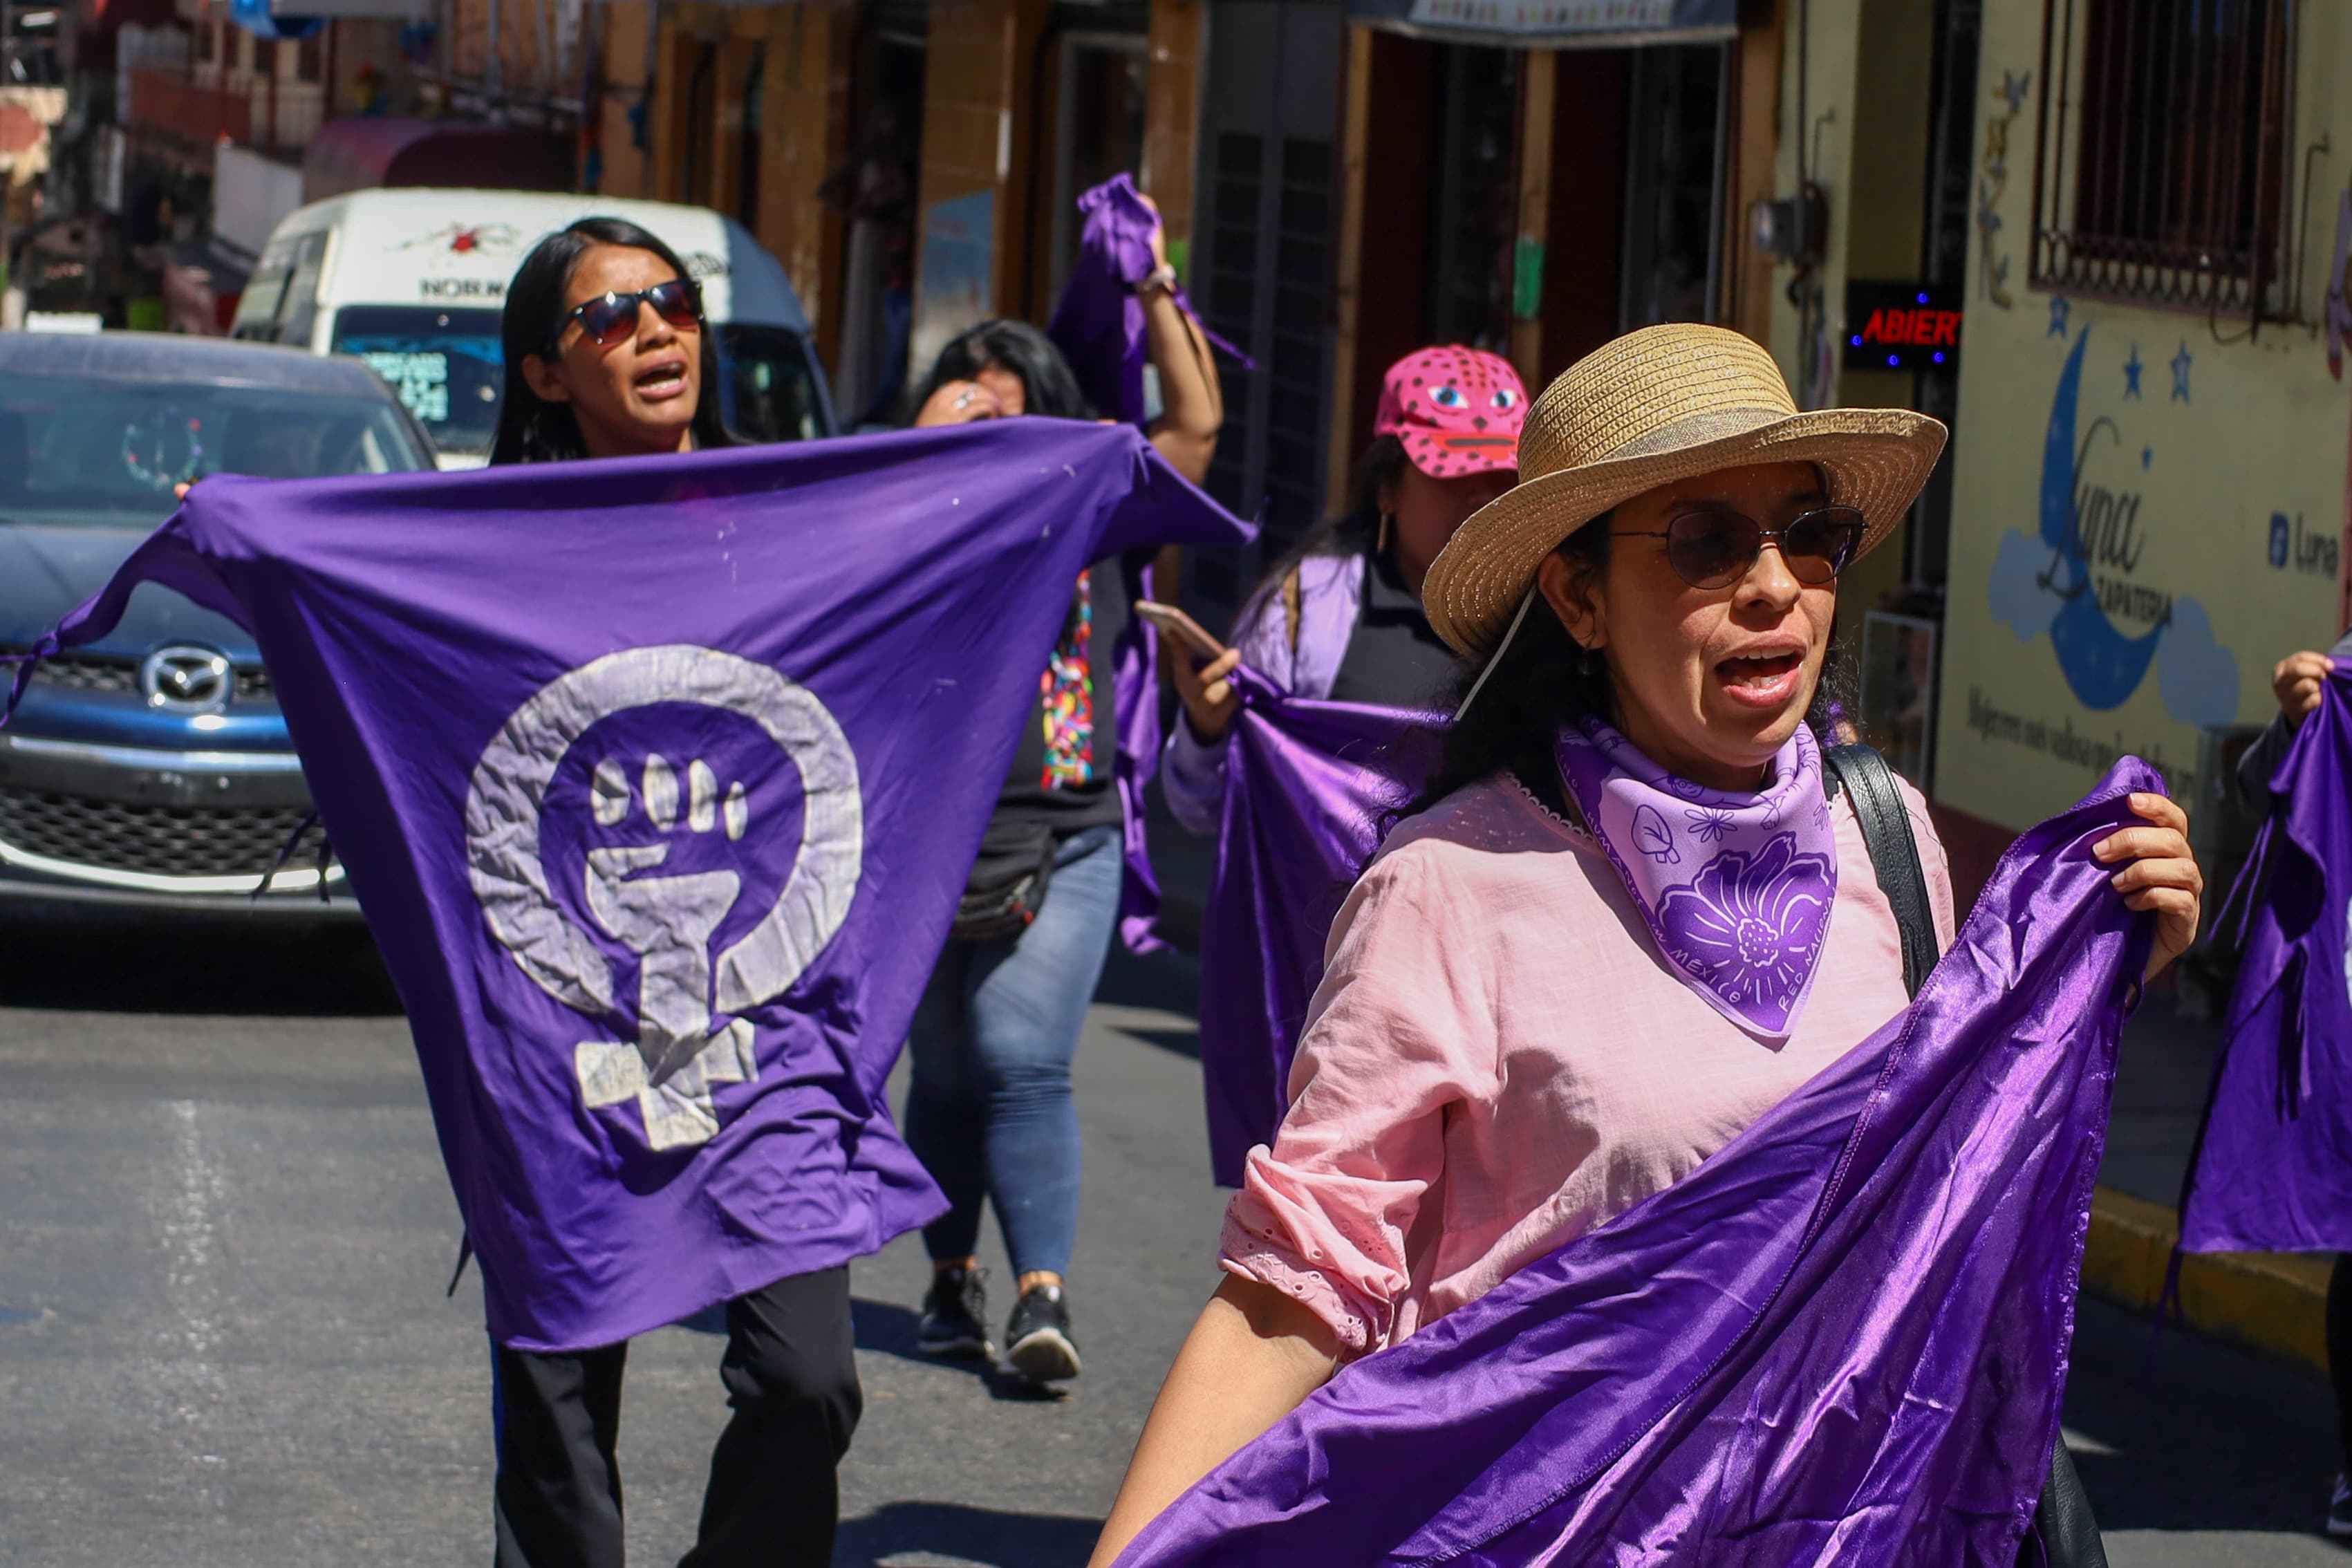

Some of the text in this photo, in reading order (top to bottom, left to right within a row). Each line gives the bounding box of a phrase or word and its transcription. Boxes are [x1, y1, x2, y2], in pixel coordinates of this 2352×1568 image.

[420, 279, 506, 297] NORM
[2035, 416, 2146, 601] Luna
[1670, 948, 1742, 1003] MÉXICO
[1777, 973, 1804, 1013] RED
